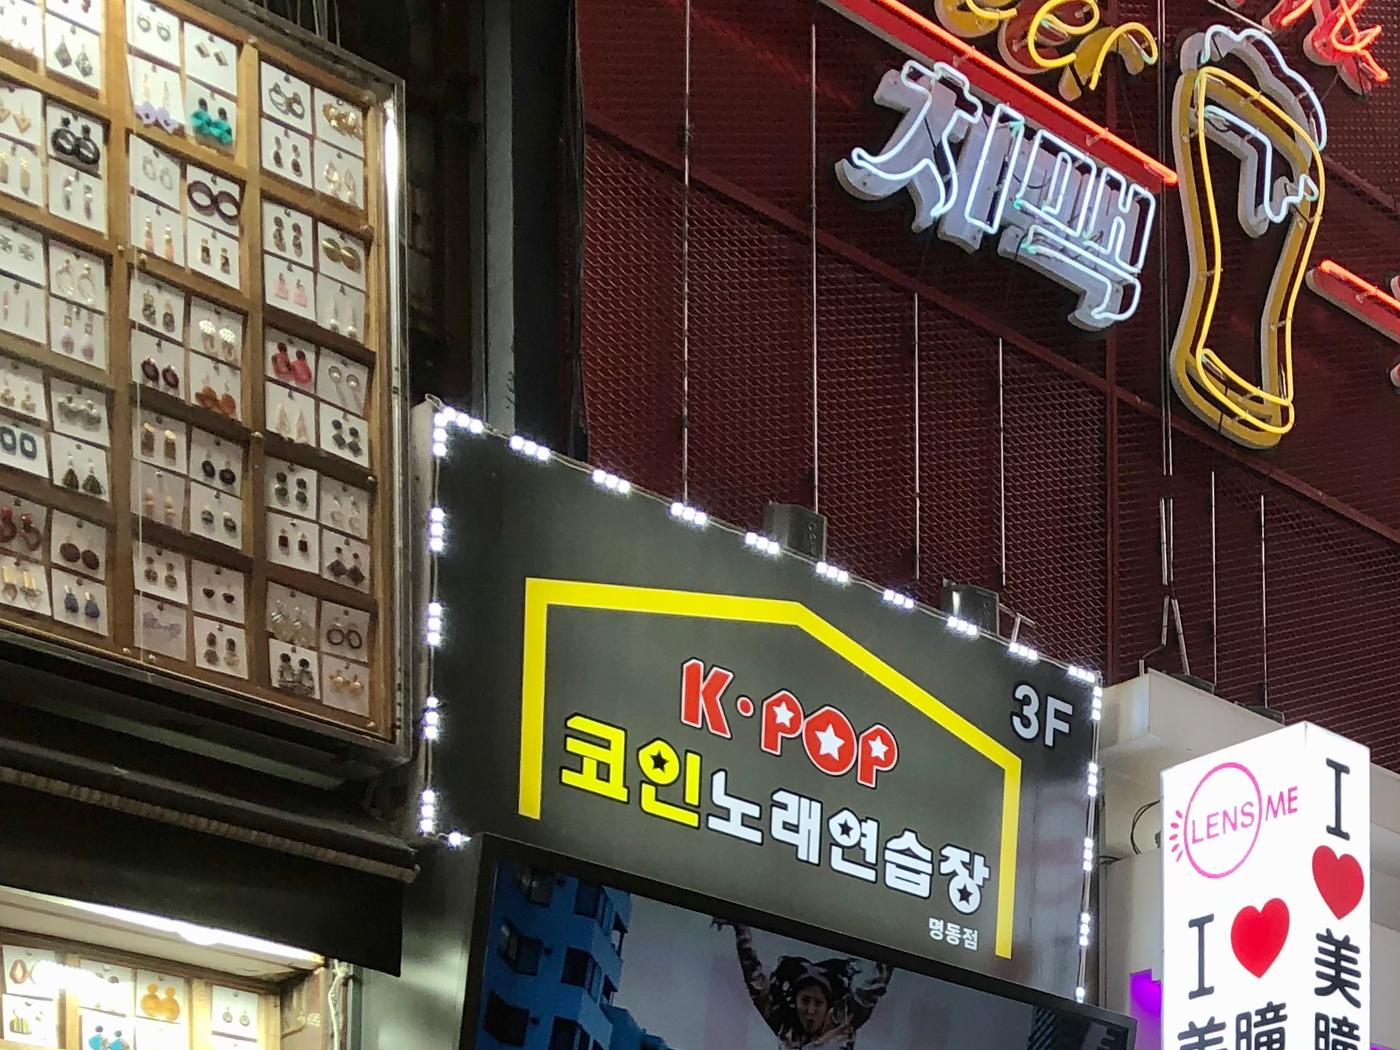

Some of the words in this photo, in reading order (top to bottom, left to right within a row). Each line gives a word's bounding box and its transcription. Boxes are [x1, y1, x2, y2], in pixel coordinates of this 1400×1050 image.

[1011, 682, 1074, 749] 3F
[1190, 799, 1256, 845] LENS
[1264, 785, 1299, 822] ME
[1325, 756, 1350, 842] I
[928, 916, 980, 952] 명동점
[1187, 912, 1215, 1001] I
